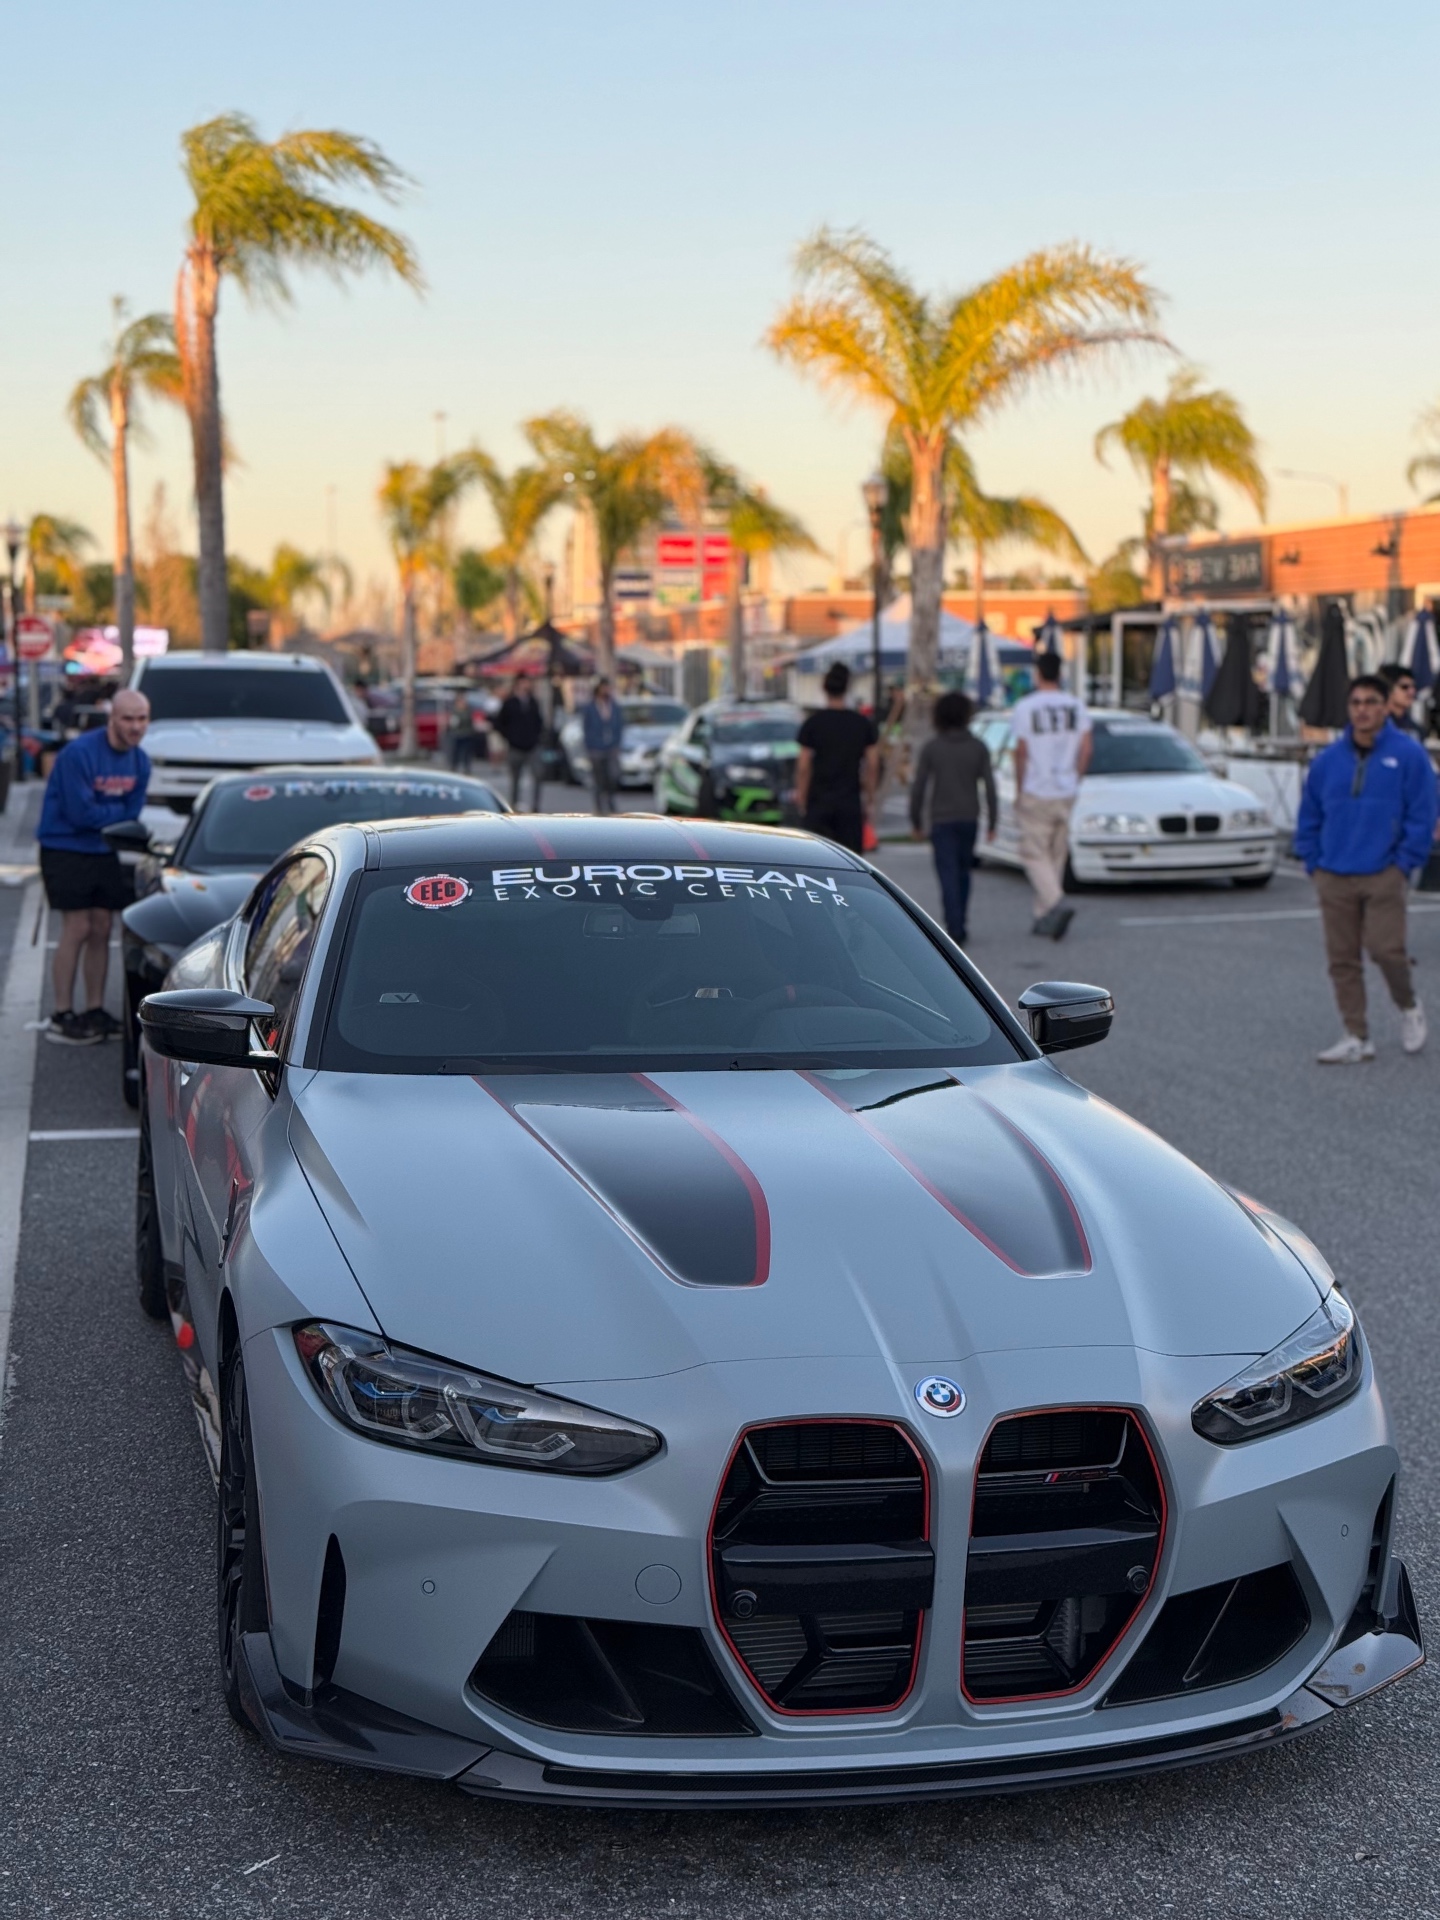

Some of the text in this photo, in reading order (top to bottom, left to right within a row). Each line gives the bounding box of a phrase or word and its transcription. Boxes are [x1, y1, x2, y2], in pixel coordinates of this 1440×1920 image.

[420, 880, 456, 901] EEC
[492, 864, 838, 892] EUROPEAN
[493, 882, 850, 907] EXOTIC CENTER
